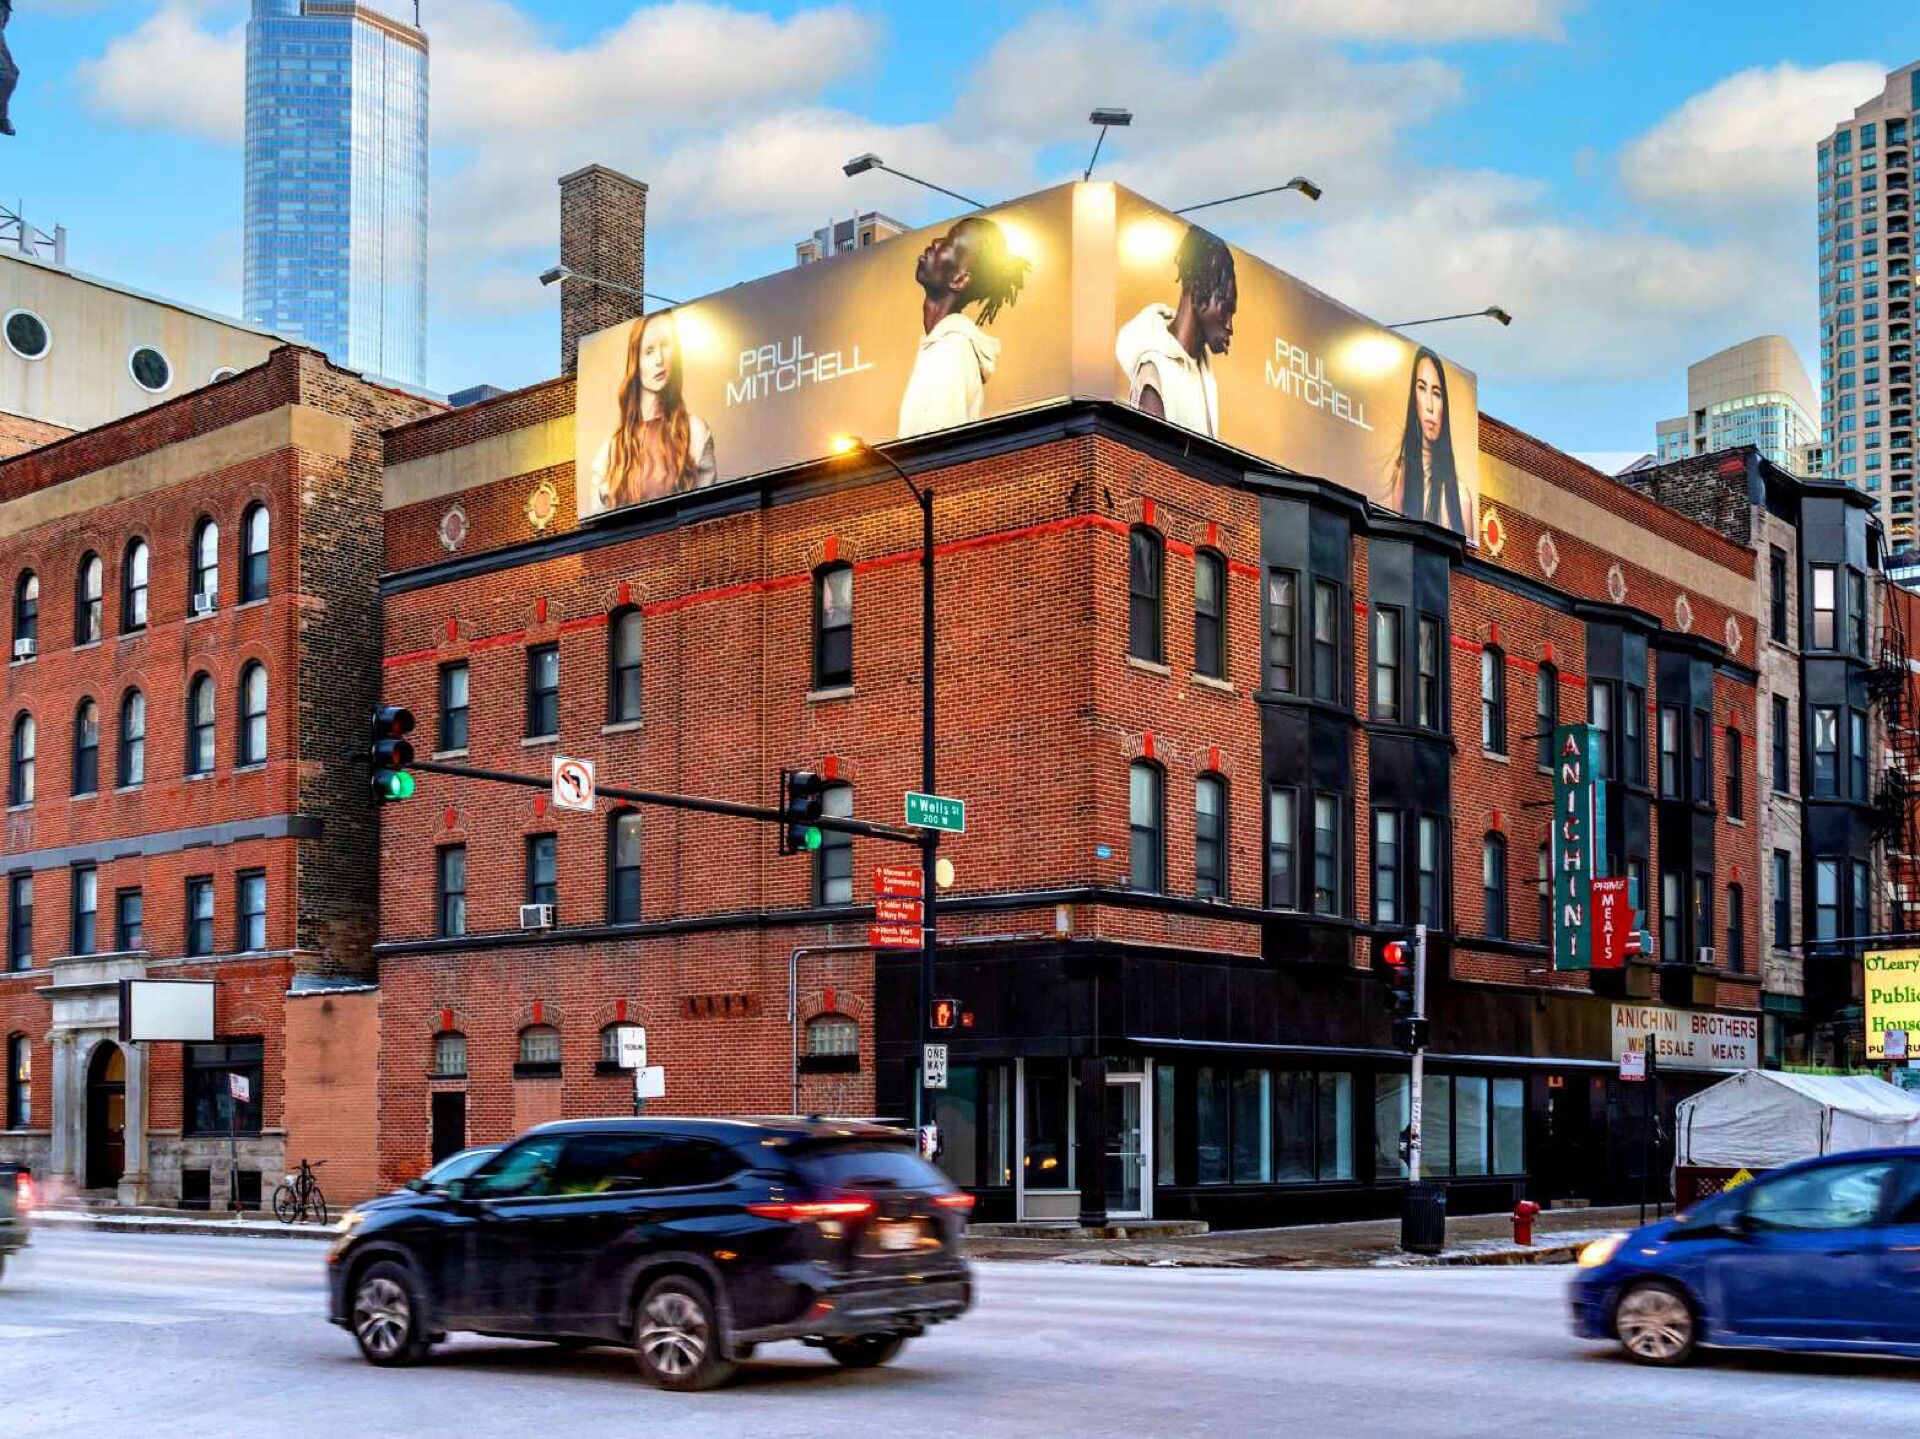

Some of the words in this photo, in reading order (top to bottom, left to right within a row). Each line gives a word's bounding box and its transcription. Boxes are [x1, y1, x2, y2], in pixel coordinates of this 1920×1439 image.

[739, 335, 815, 377] PAUL
[1276, 336, 1333, 388] PAUL
[726, 345, 875, 407] MITCHELL
[1265, 358, 1375, 432] MITCHELL
[911, 799, 917, 808] N
[920, 798, 949, 815] Wells
[923, 814, 939, 824] 200
[941, 816, 948, 825] W
[1561, 733, 1581, 956] ANICHINI
[883, 867, 906, 877] Museum
[883, 876, 920, 889] Contemporary
[1593, 881, 1625, 892] PRIME
[1601, 893, 1615, 960] MEATS
[1616, 1007, 1678, 1032] ANICHINI
[1692, 1014, 1757, 1040] BROTHERS
[927, 1048, 945, 1060] ONE
[1628, 1036, 1695, 1057] WHESALE
[1711, 1042, 1747, 1061] MEATS
[927, 1060, 945, 1071] WAY
